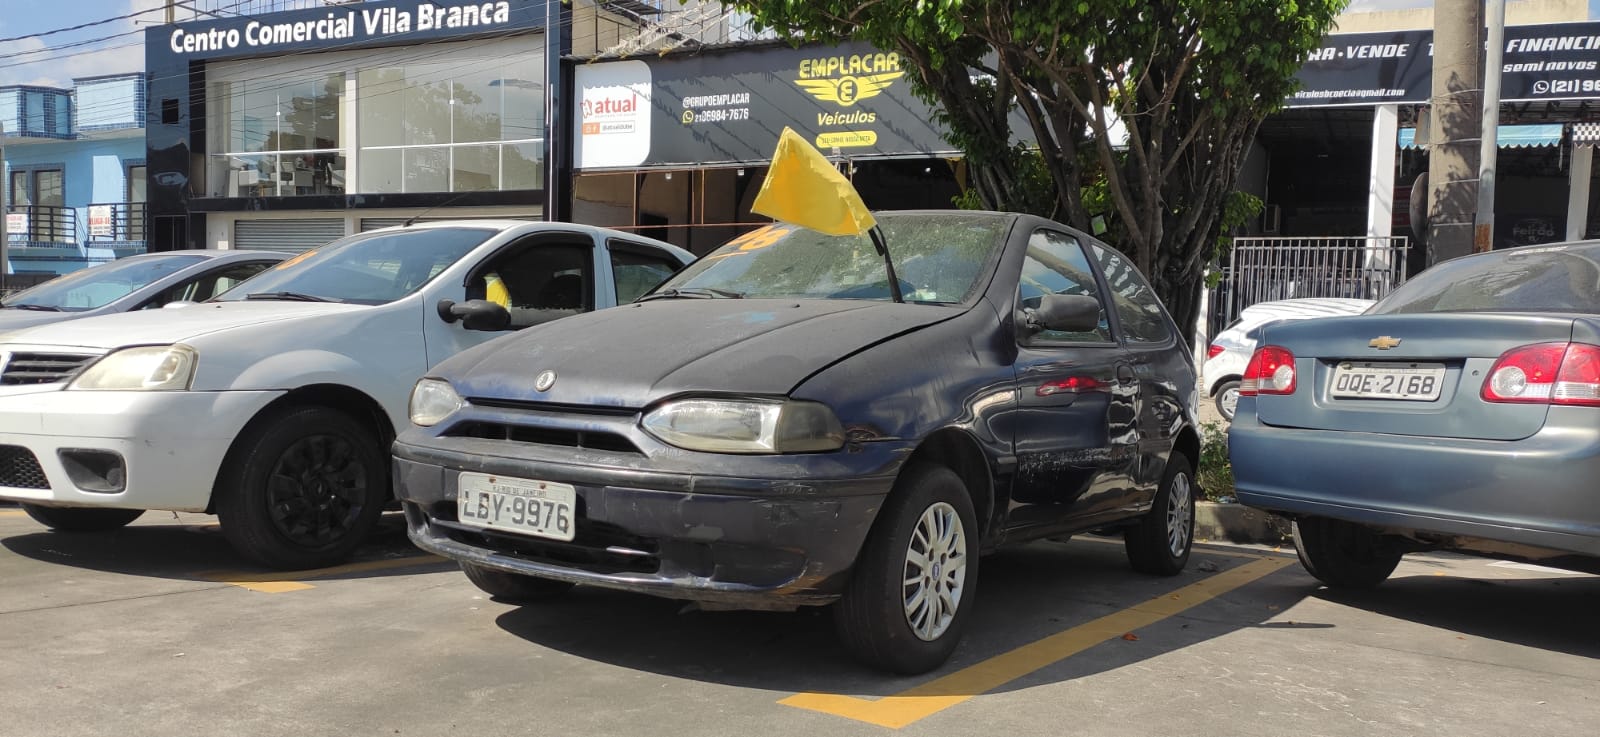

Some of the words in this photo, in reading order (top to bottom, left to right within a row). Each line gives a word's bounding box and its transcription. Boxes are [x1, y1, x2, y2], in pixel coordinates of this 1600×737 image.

[170, 28, 240, 53] Centro
[245, 11, 355, 46] Comercial
[362, 7, 411, 35] Vila
[417, 1, 510, 31] Branca
[1346, 44, 1410, 59] VENDE
[799, 52, 900, 78] EMPLACAR
[1502, 61, 1545, 73] semi
[1545, 61, 1598, 71] novos
[1550, 79, 1580, 93] (21)
[594, 93, 637, 114] atual
[682, 92, 750, 108] @GRUPOEMPLACAR
